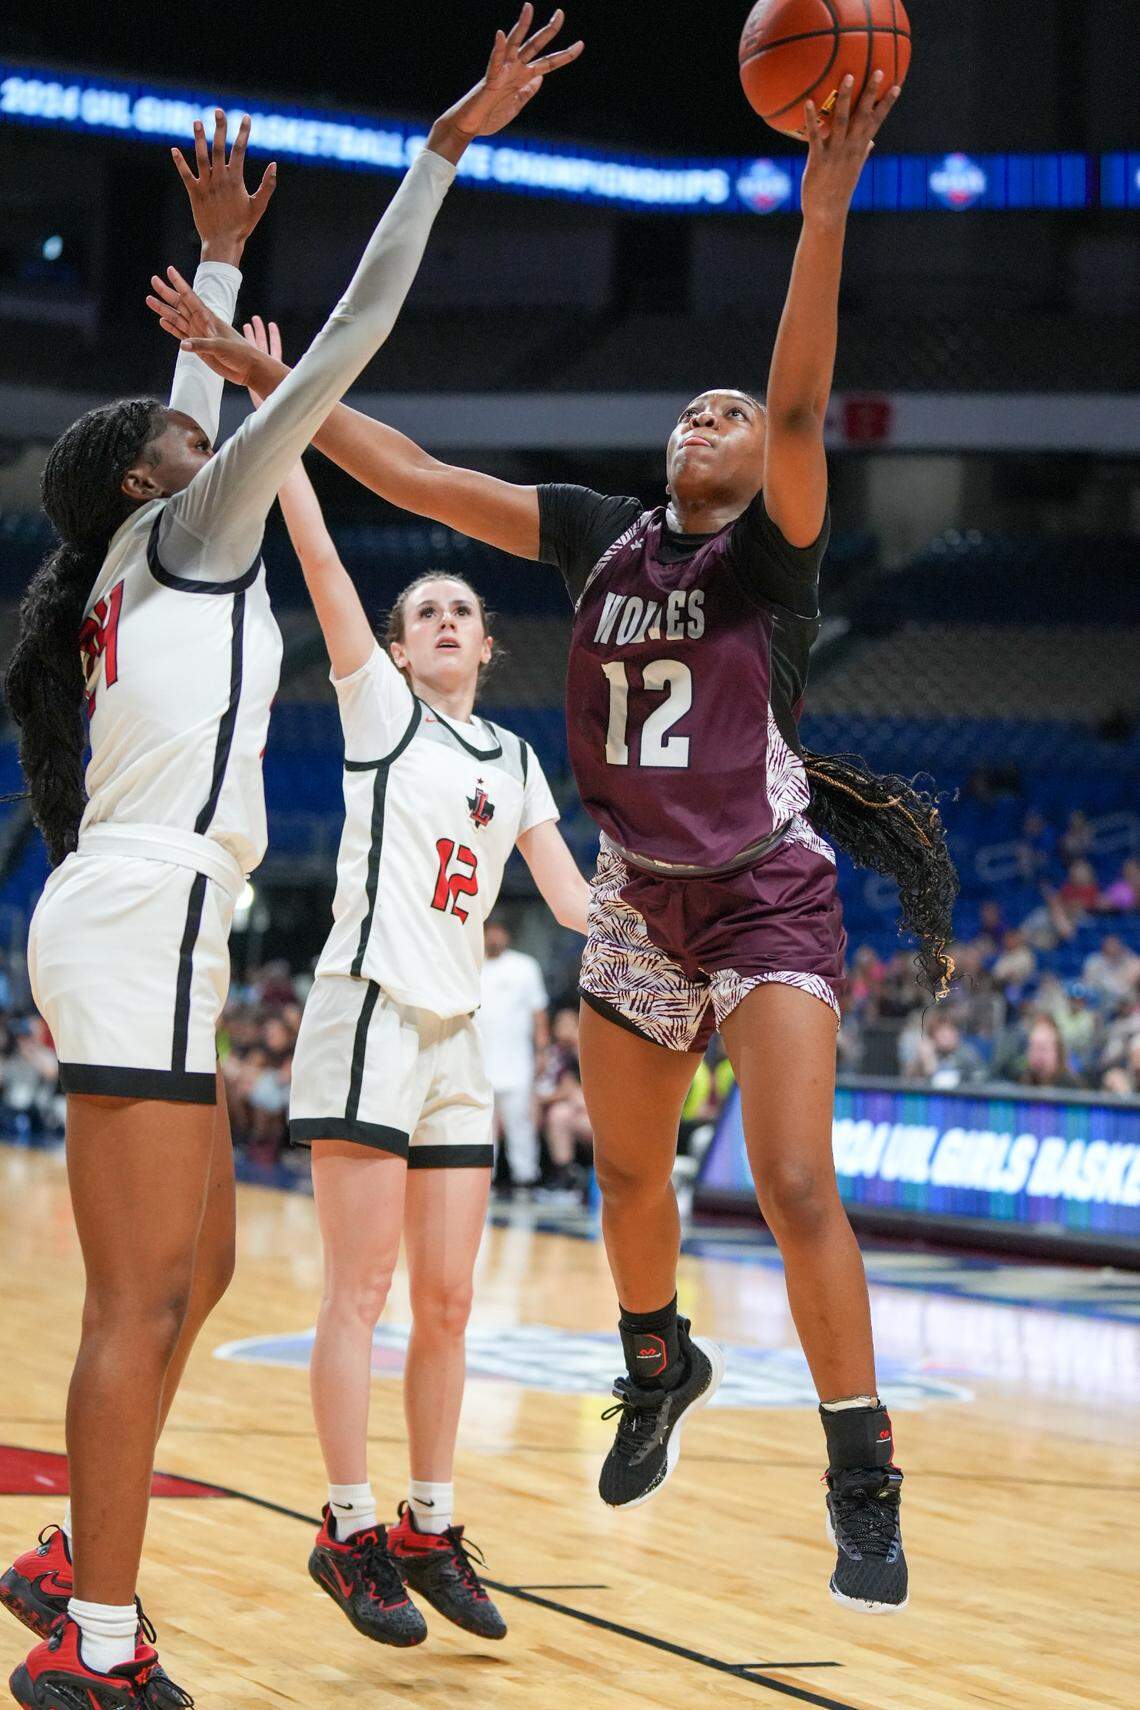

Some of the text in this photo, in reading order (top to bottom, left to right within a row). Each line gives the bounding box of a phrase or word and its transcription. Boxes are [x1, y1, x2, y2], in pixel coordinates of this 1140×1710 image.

[2, 78, 80, 119] 2024
[601, 658, 693, 767] 12
[430, 837, 479, 925] 12
[931, 1127, 1038, 1194] GIRLS
